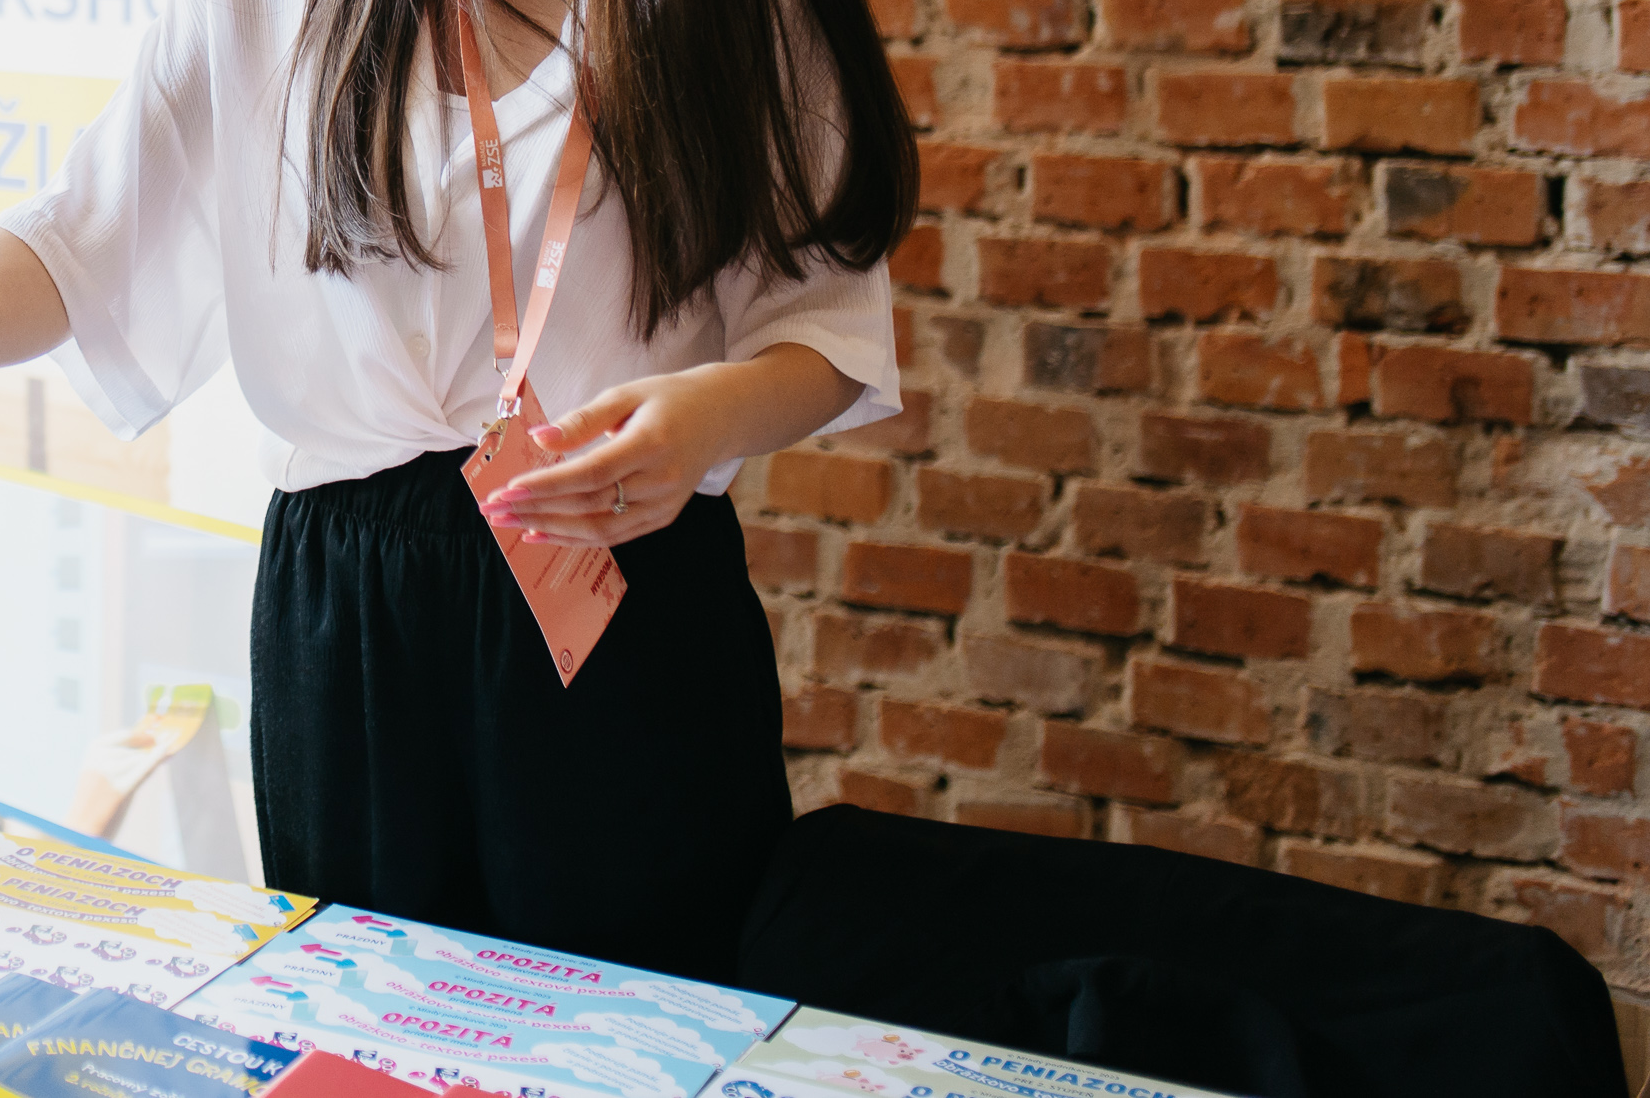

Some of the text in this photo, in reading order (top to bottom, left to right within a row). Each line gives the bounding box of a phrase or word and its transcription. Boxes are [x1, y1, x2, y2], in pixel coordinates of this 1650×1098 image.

[486, 138, 501, 168] ZSE
[547, 240, 565, 269] ZSE
[16, 847, 35, 857] O
[38, 851, 183, 889] PENIAZOCH
[1, 877, 147, 916] PENIAZOCH
[83, 914, 137, 924] pexeso
[476, 950, 603, 984] OPOZITÁ
[428, 980, 558, 1017] OPOZITÁ
[513, 976, 572, 992] textové
[577, 987, 636, 998] pexeso
[381, 1012, 514, 1049] OPOZITÁ
[26, 1038, 184, 1069] FINANČNEJ
[173, 1034, 264, 1070] CESTOU
[420, 1042, 482, 1058] textové
[488, 1054, 549, 1064] pexeso
[948, 1049, 971, 1061] O
[935, 1059, 1019, 1093] obrázkovo
